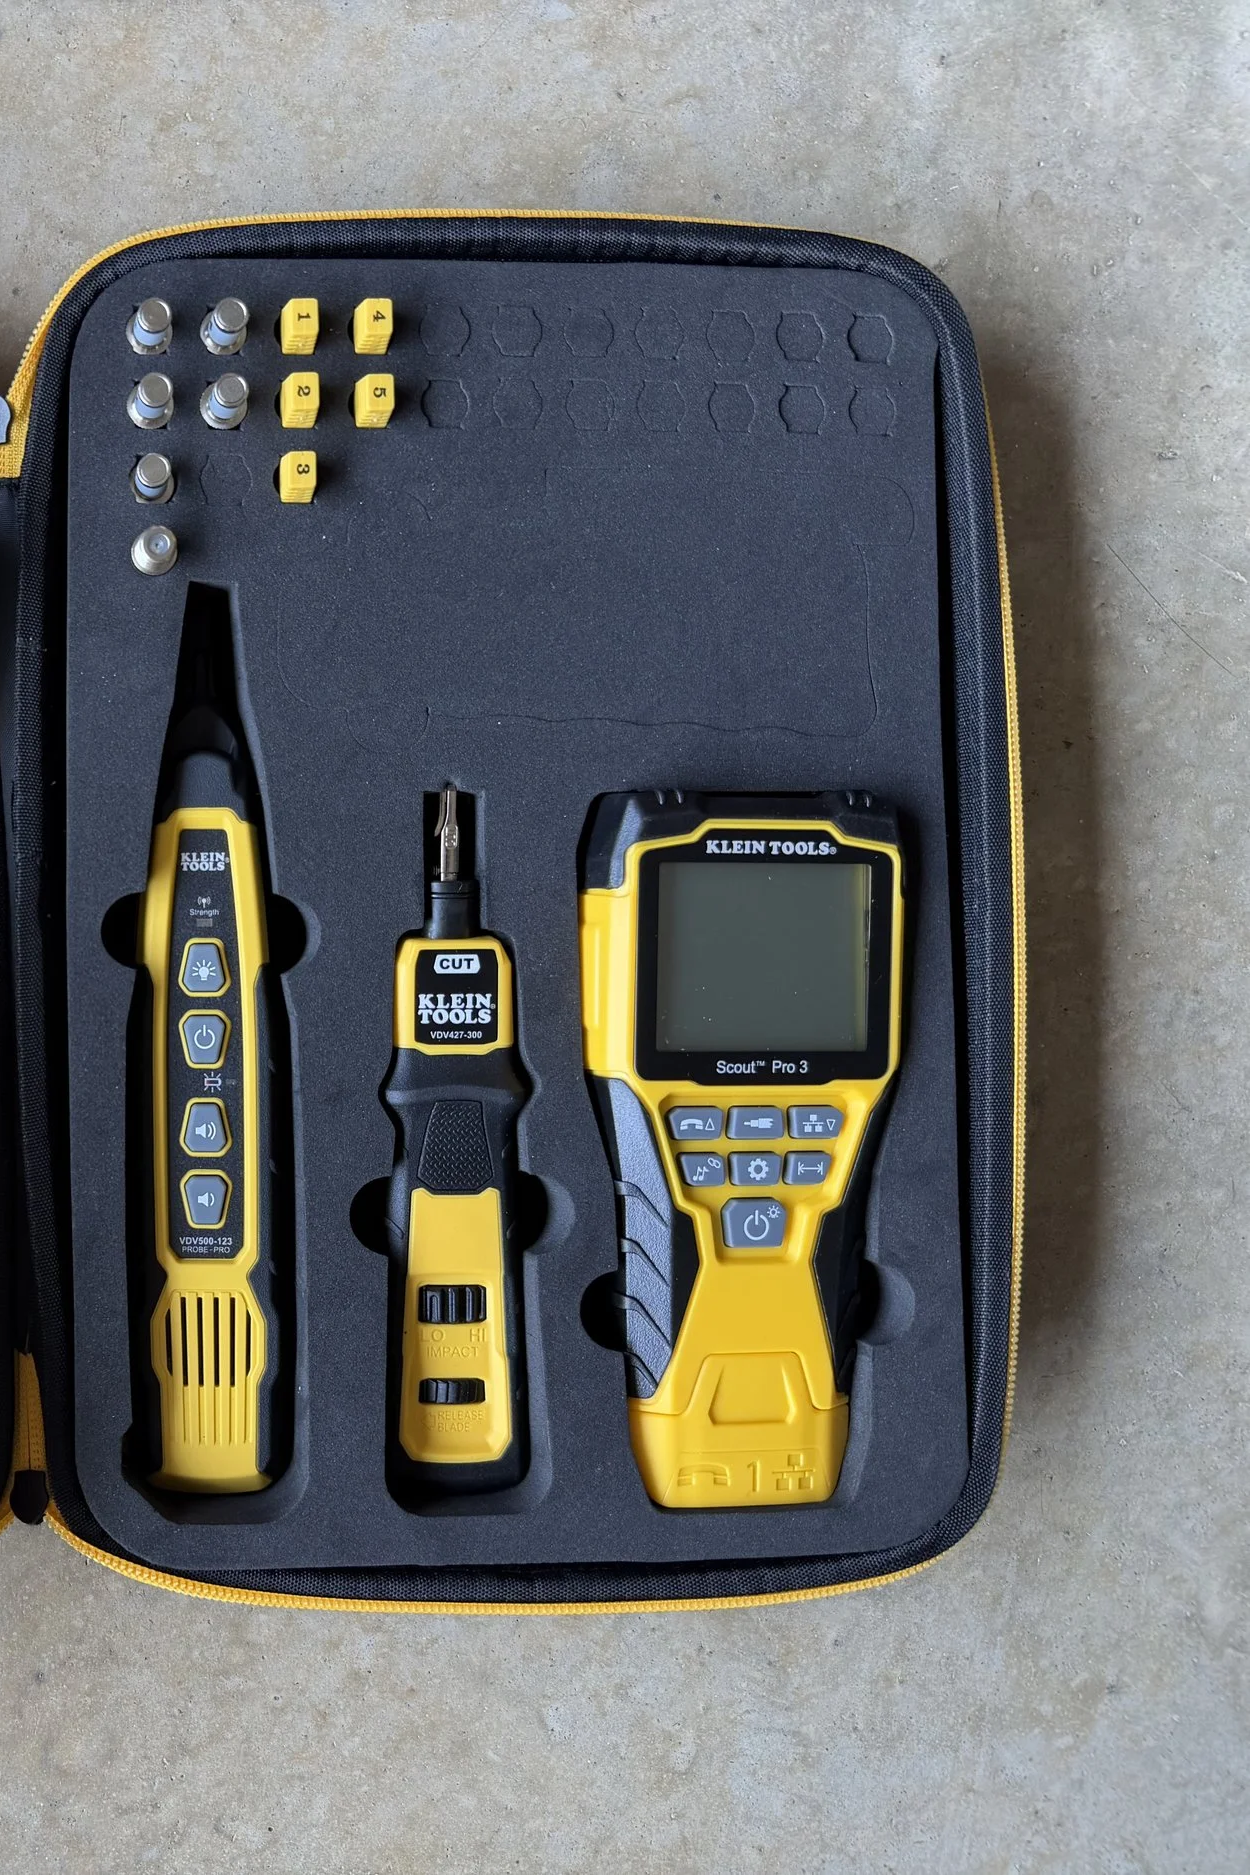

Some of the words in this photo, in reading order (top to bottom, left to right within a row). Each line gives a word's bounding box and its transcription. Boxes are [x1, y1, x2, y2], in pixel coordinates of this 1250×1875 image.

[297, 312, 311, 322] 1
[373, 310, 386, 323] 4
[297, 385, 311, 397] 2
[373, 387, 387, 398] 5
[297, 463, 310, 475] 3
[706, 840, 765, 854] KLEIN
[181, 862, 225, 871] TOOLS
[190, 908, 220, 917] Strength
[439, 958, 474, 969] CUT
[418, 1009, 492, 1024] TOOLS
[430, 1031, 482, 1039] VDV427-300
[772, 1060, 796, 1074] Pro
[799, 1060, 808, 1074] 3
[179, 1237, 232, 1246] VDV500-123
[420, 1328, 445, 1342] LO
[470, 1329, 487, 1342] HI
[427, 1346, 479, 1357] IMPACT
[438, 1410, 484, 1420] RELEASE
[438, 1422, 471, 1432] BLADE
